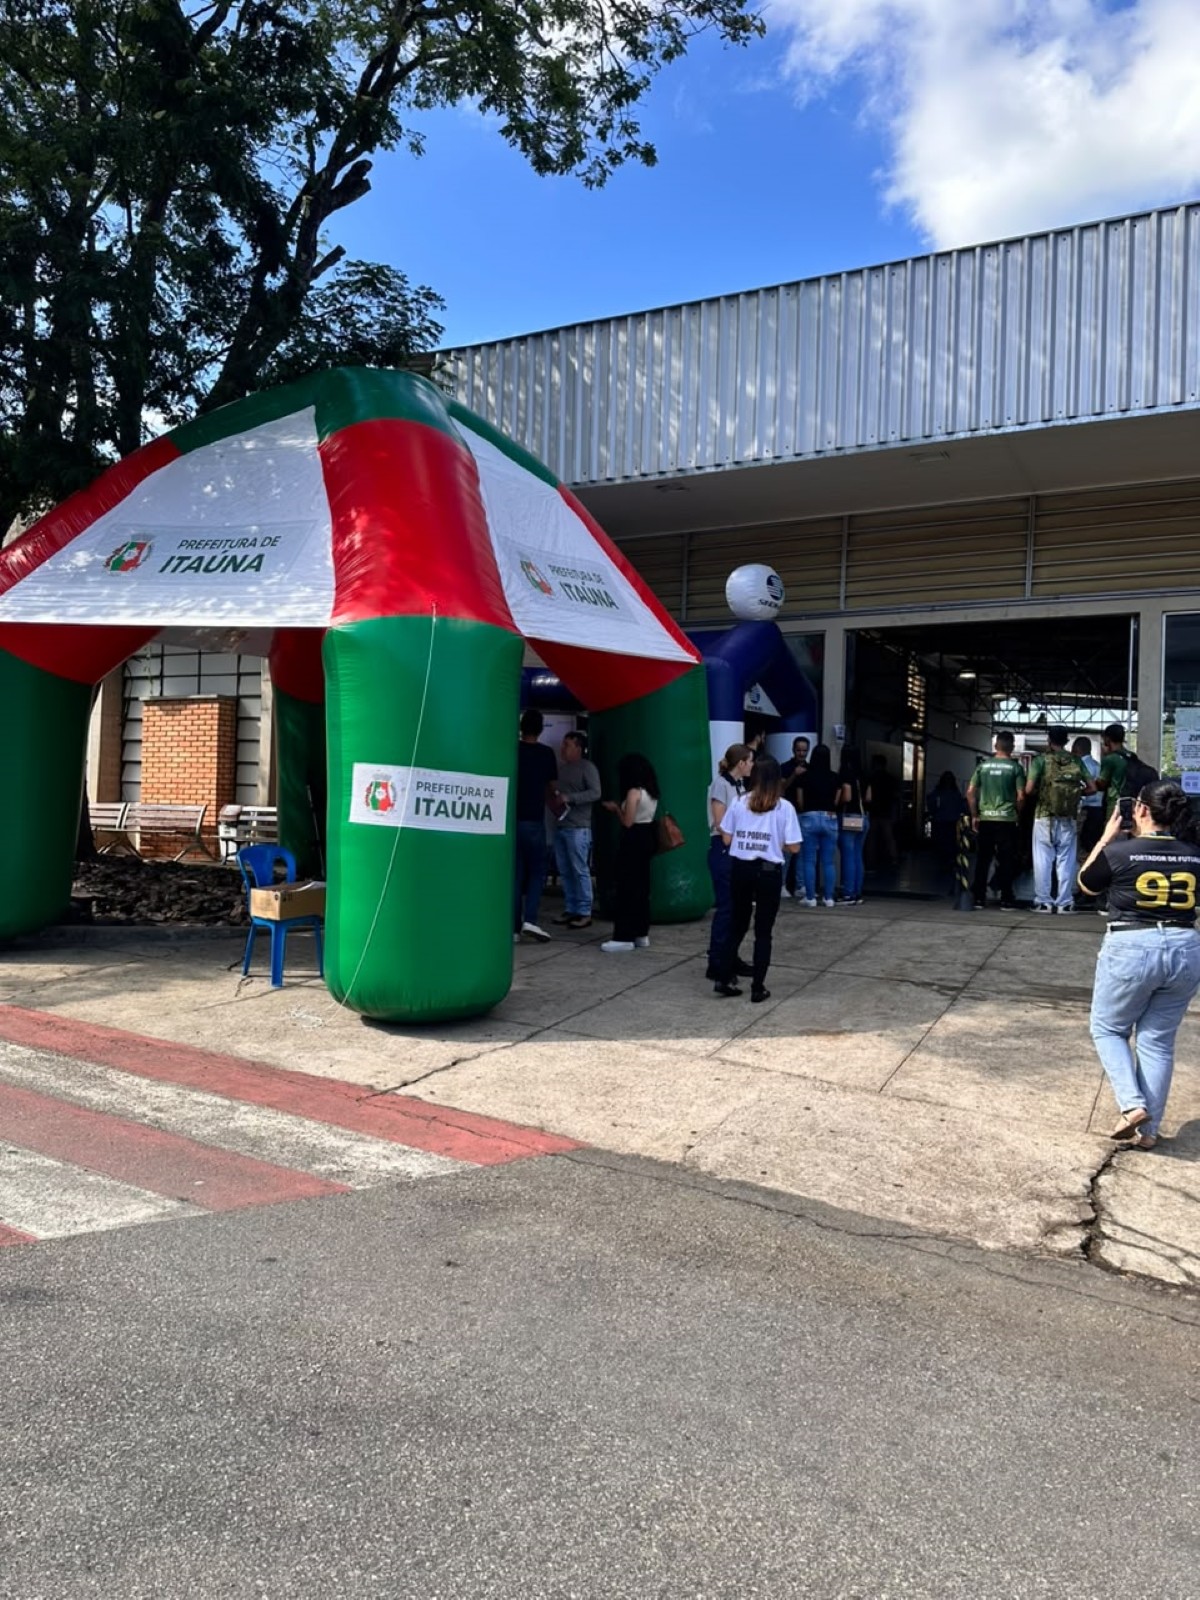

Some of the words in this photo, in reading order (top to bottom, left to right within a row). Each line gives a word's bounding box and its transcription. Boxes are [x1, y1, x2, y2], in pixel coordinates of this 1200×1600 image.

[178, 537, 257, 550] PREFEITURA
[261, 536, 281, 547] DE
[158, 550, 265, 573] ITAÚNA
[559, 580, 620, 610] ITAÚNA
[416, 781, 481, 797] PREFEITURA
[483, 788, 495, 798] DE
[414, 795, 493, 822] ITAÚNA
[1129, 854, 1167, 862] PORTADOR
[1135, 871, 1197, 910] 93
